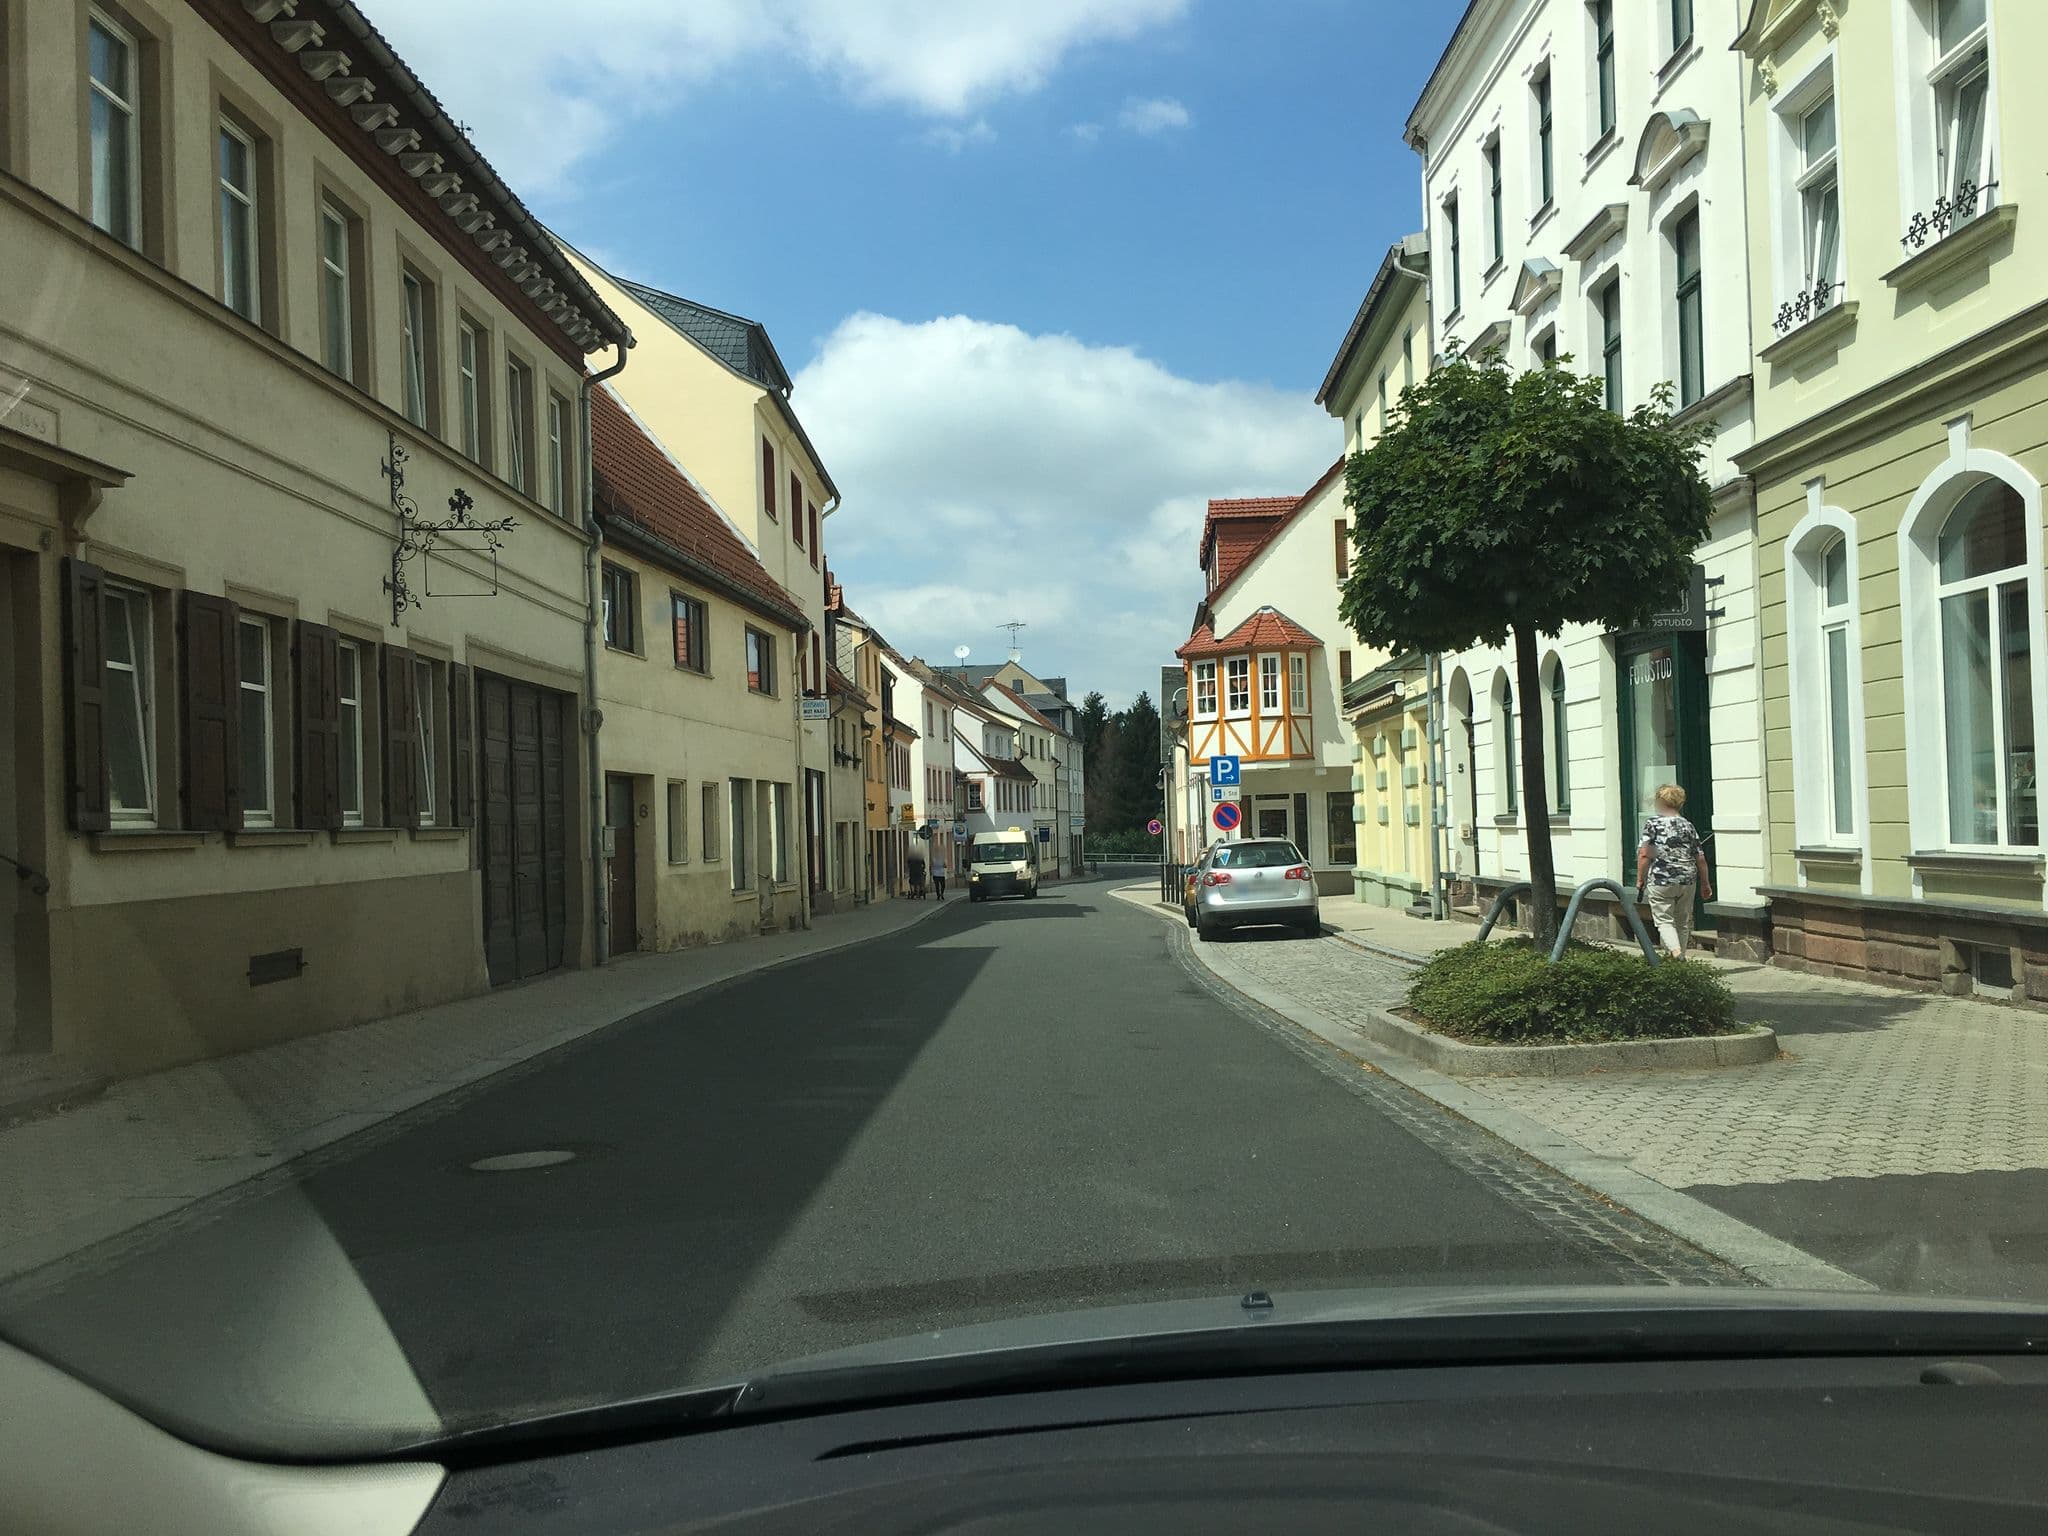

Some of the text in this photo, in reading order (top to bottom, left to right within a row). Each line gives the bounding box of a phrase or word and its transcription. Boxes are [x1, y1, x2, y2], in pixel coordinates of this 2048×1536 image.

[1632, 618, 1693, 628] FOSTUDIO
[1217, 759, 1232, 782] P
[1458, 763, 1465, 773] 5
[639, 803, 649, 819] 6
